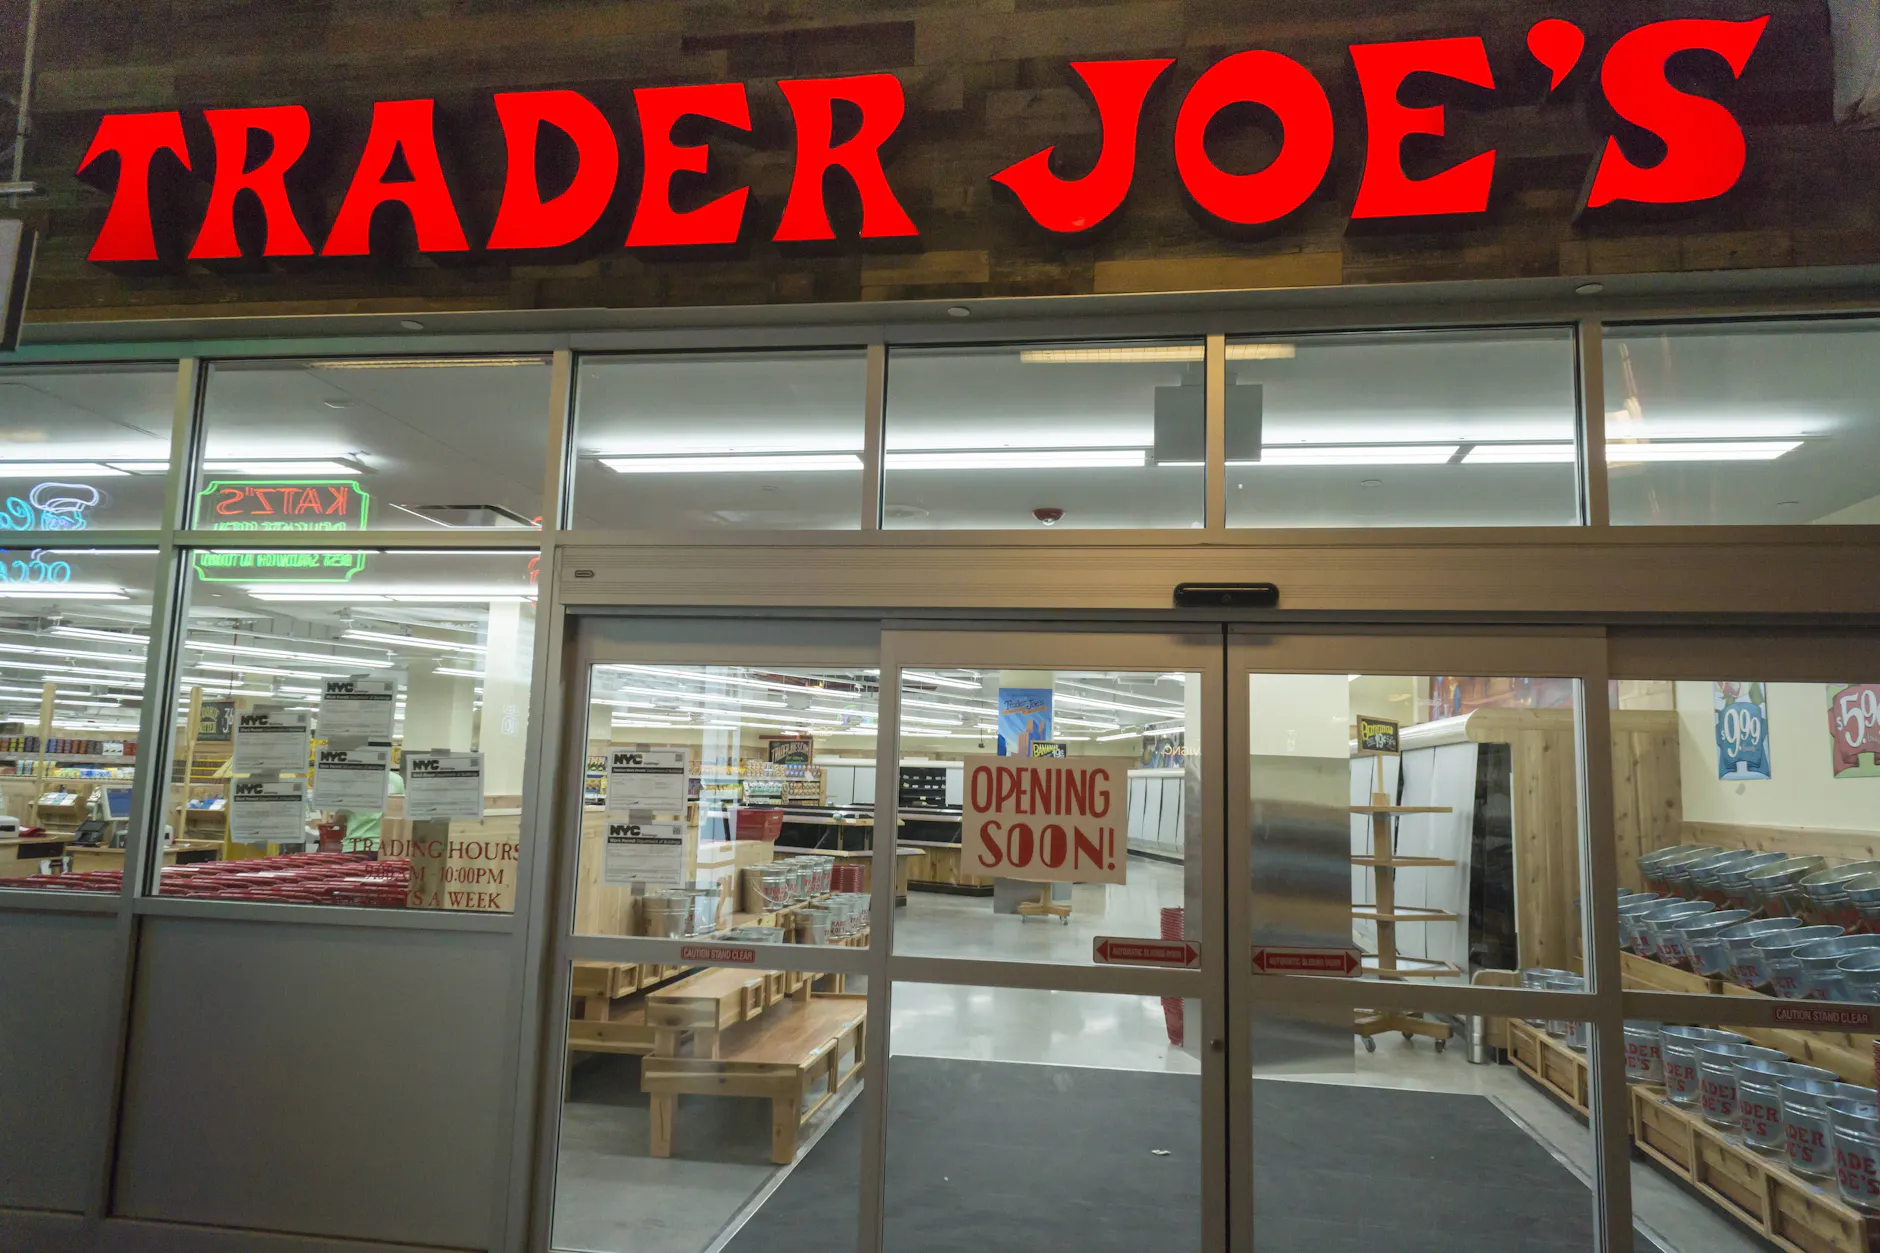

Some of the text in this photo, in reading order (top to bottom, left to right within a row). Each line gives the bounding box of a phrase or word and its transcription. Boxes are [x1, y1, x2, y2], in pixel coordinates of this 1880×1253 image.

[76, 14, 1771, 261] TRADER JOE'S
[326, 682, 354, 693] NYC
[240, 715, 268, 725] NYC
[1836, 689, 1880, 748] $5.9
[320, 751, 348, 762] NYC
[614, 754, 643, 764] NYC
[413, 760, 440, 770] NYC
[236, 784, 263, 794] NYC
[971, 765, 1110, 818] OPENING
[610, 825, 641, 836] NYC
[351, 838, 520, 862] TRADING HOURS
[978, 820, 1115, 871] SOON!
[440, 866, 504, 885] 10:00PM
[428, 891, 440, 907] A
[447, 891, 501, 909] WEEK
[684, 948, 752, 961] CAUTION STAND CLEAR
[1776, 1008, 1868, 1024] CAUTION STAND CLEAR
